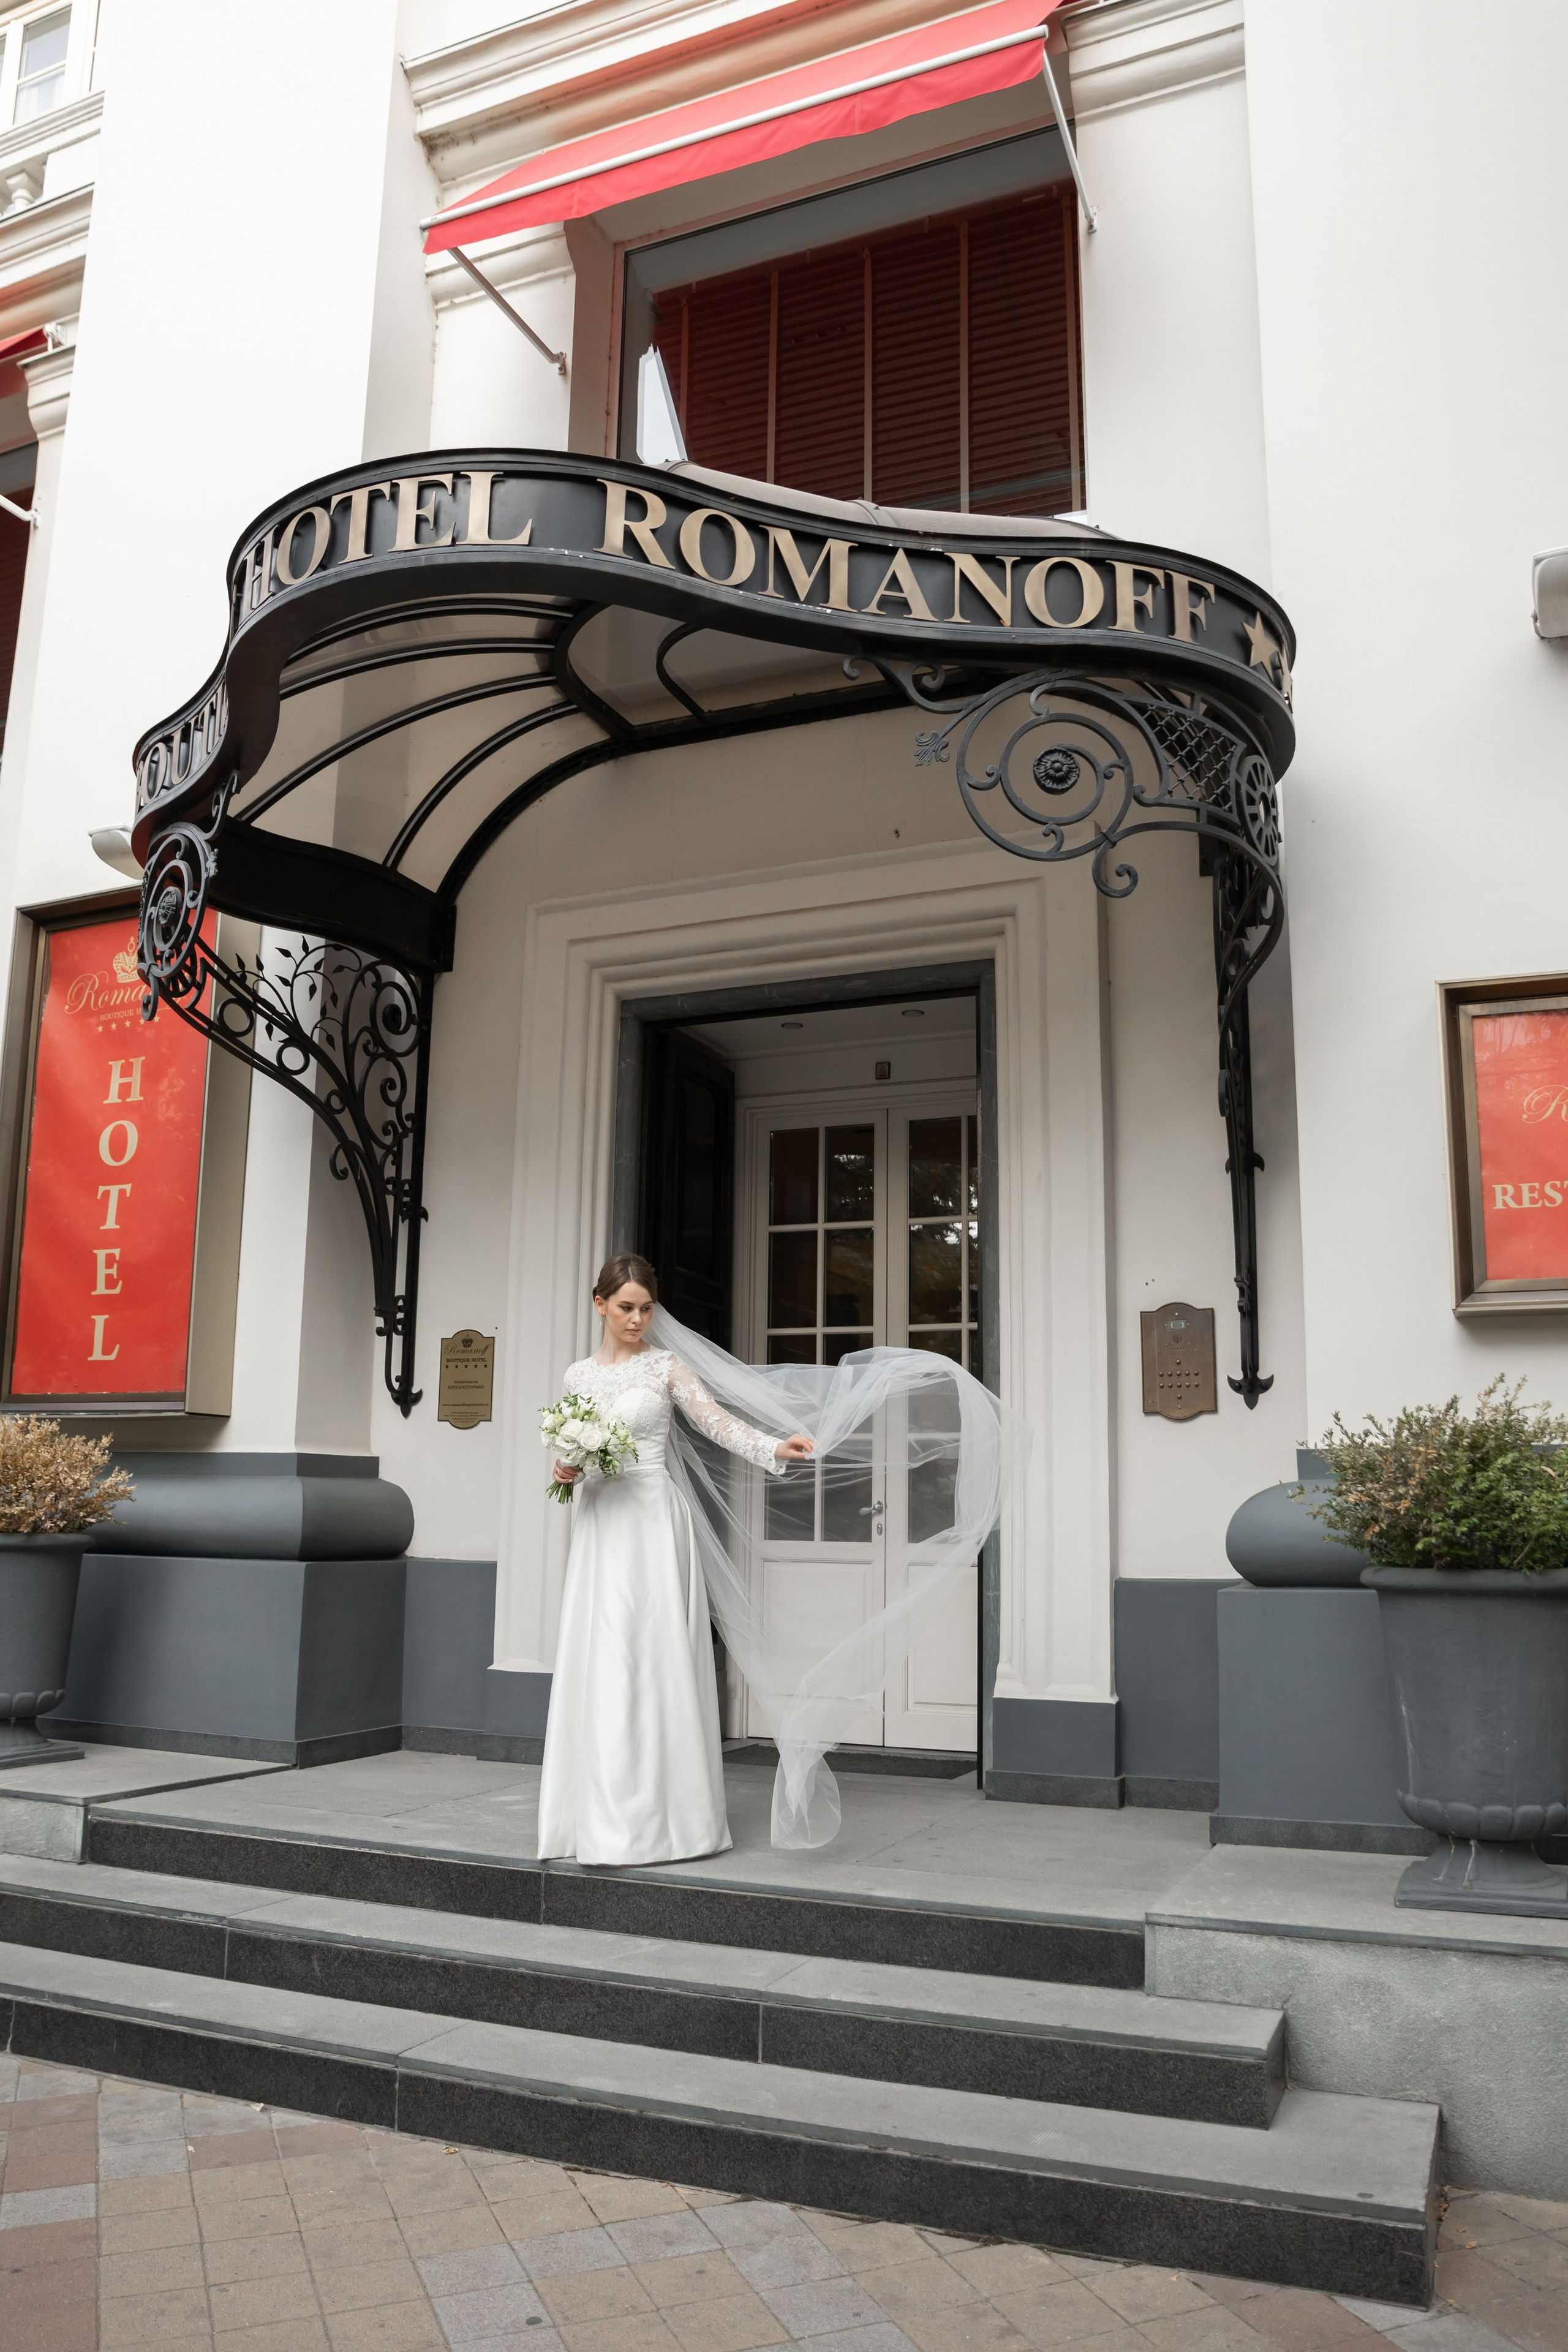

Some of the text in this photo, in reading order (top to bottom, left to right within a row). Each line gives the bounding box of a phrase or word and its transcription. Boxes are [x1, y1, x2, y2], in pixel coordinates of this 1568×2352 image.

[239, 471, 1215, 644] HOTEL ROMANOFF
[100, 1009, 134, 1022] BOUTIQUE
[88, 1056, 146, 1361] HOTEL
[1491, 1181, 1568, 1210] RES
[444, 1342, 489, 1357] Romanoff
